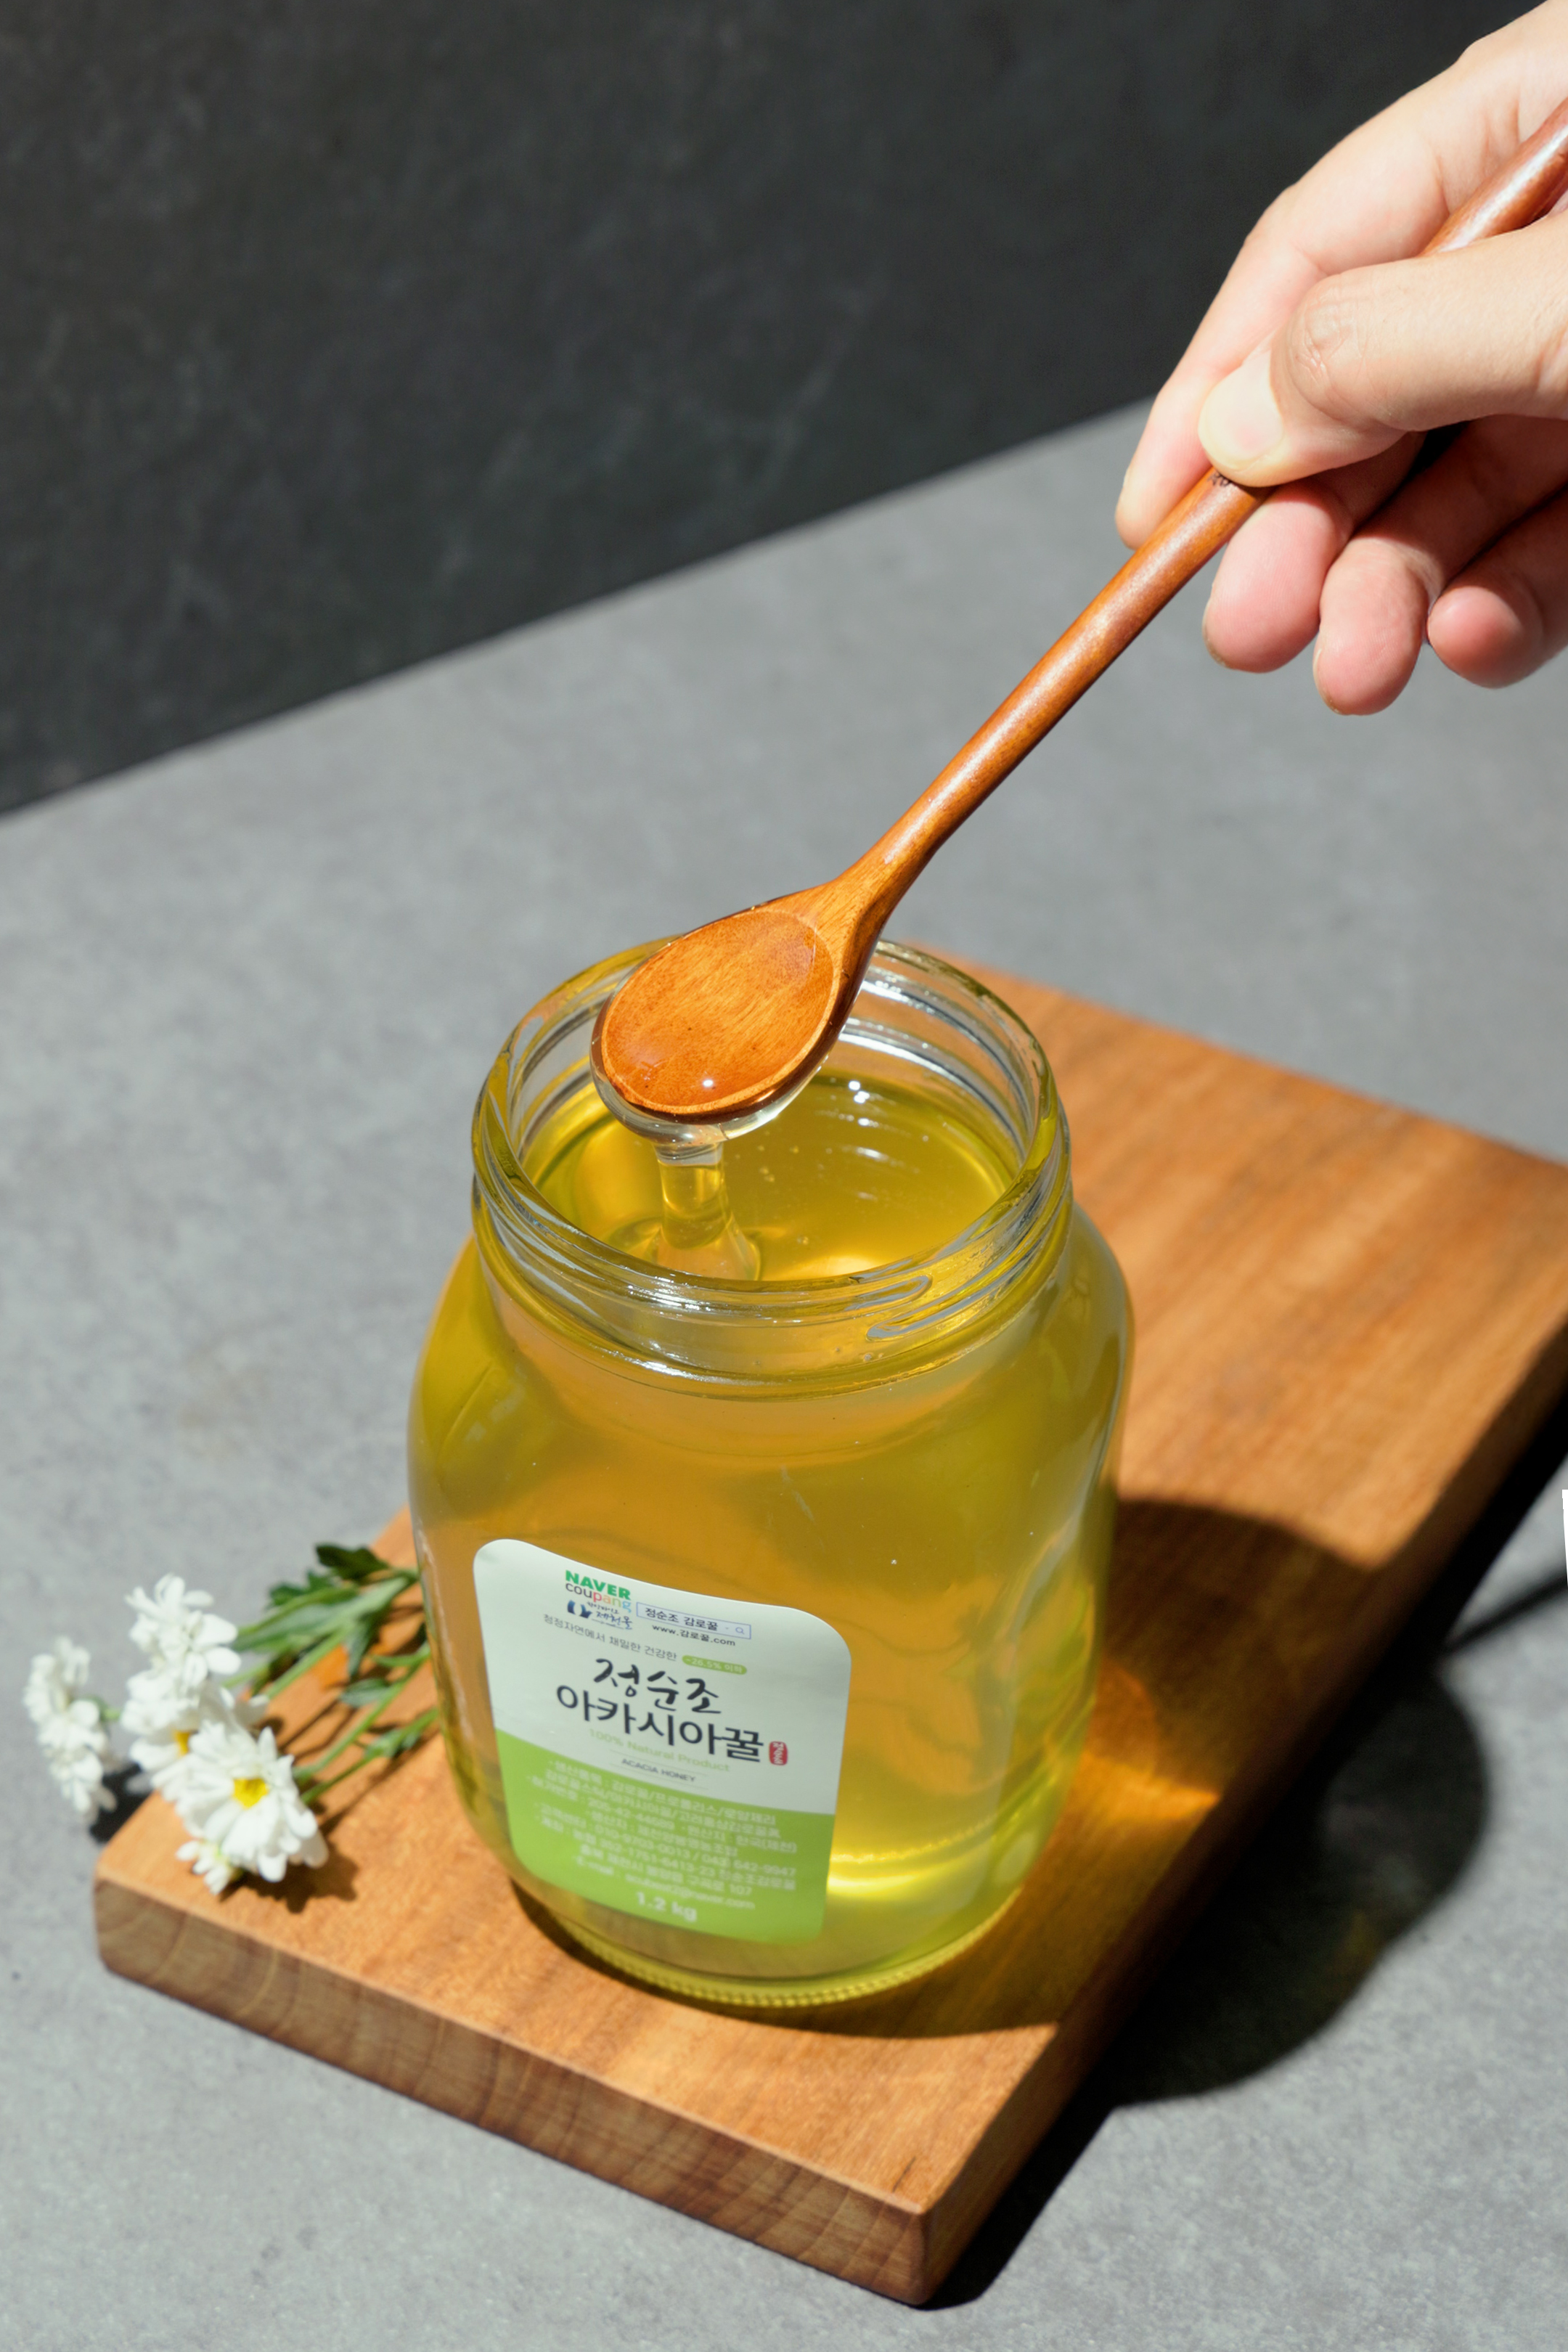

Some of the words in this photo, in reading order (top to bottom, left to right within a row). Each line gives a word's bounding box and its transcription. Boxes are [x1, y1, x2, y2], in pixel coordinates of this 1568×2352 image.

[565, 1570, 632, 1600] NAVER
[565, 1583, 632, 1613] coupang
[645, 1606, 679, 1623] 정순조
[684, 1615, 719, 1632] 감로꿀
[609, 1636, 641, 1652] 채밀한
[645, 1645, 677, 1662] 건강한
[652, 1625, 736, 1646] www.감로꿀.com
[593, 1658, 722, 1714] 정순조
[556, 1685, 764, 1763] 아카시아꿀
[589, 1728, 624, 1747] 100%
[626, 1739, 675, 1760] Natural
[678, 1752, 731, 1772] Product
[621, 1758, 659, 1773] ACACIA
[661, 1768, 696, 1781] HONEY
[637, 1891, 666, 1912] 1.2
[671, 1901, 698, 1923] kg
